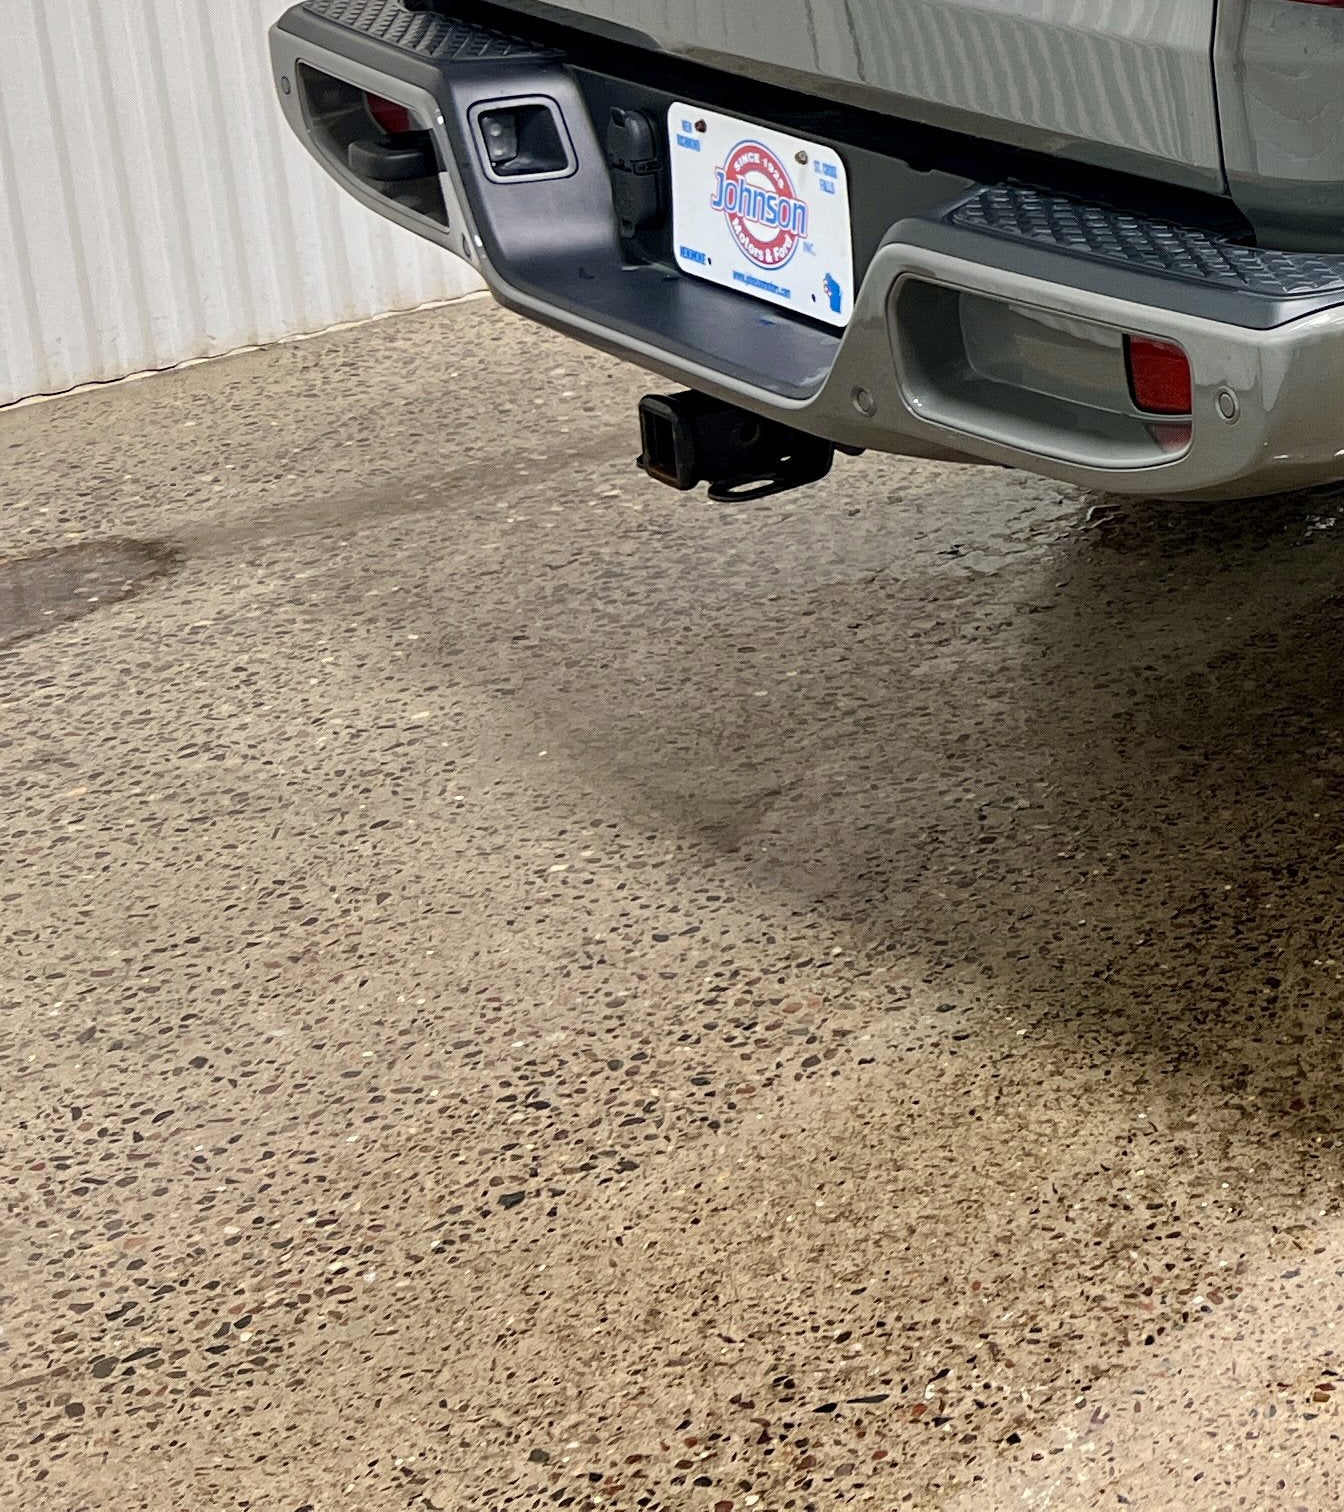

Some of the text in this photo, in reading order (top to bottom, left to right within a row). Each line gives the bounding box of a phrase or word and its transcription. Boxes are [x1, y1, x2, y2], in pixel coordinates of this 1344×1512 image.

[733, 152, 760, 172] SINCE
[711, 169, 808, 237] Johnson
[731, 218, 764, 262] Motors
[765, 251, 774, 264] &
